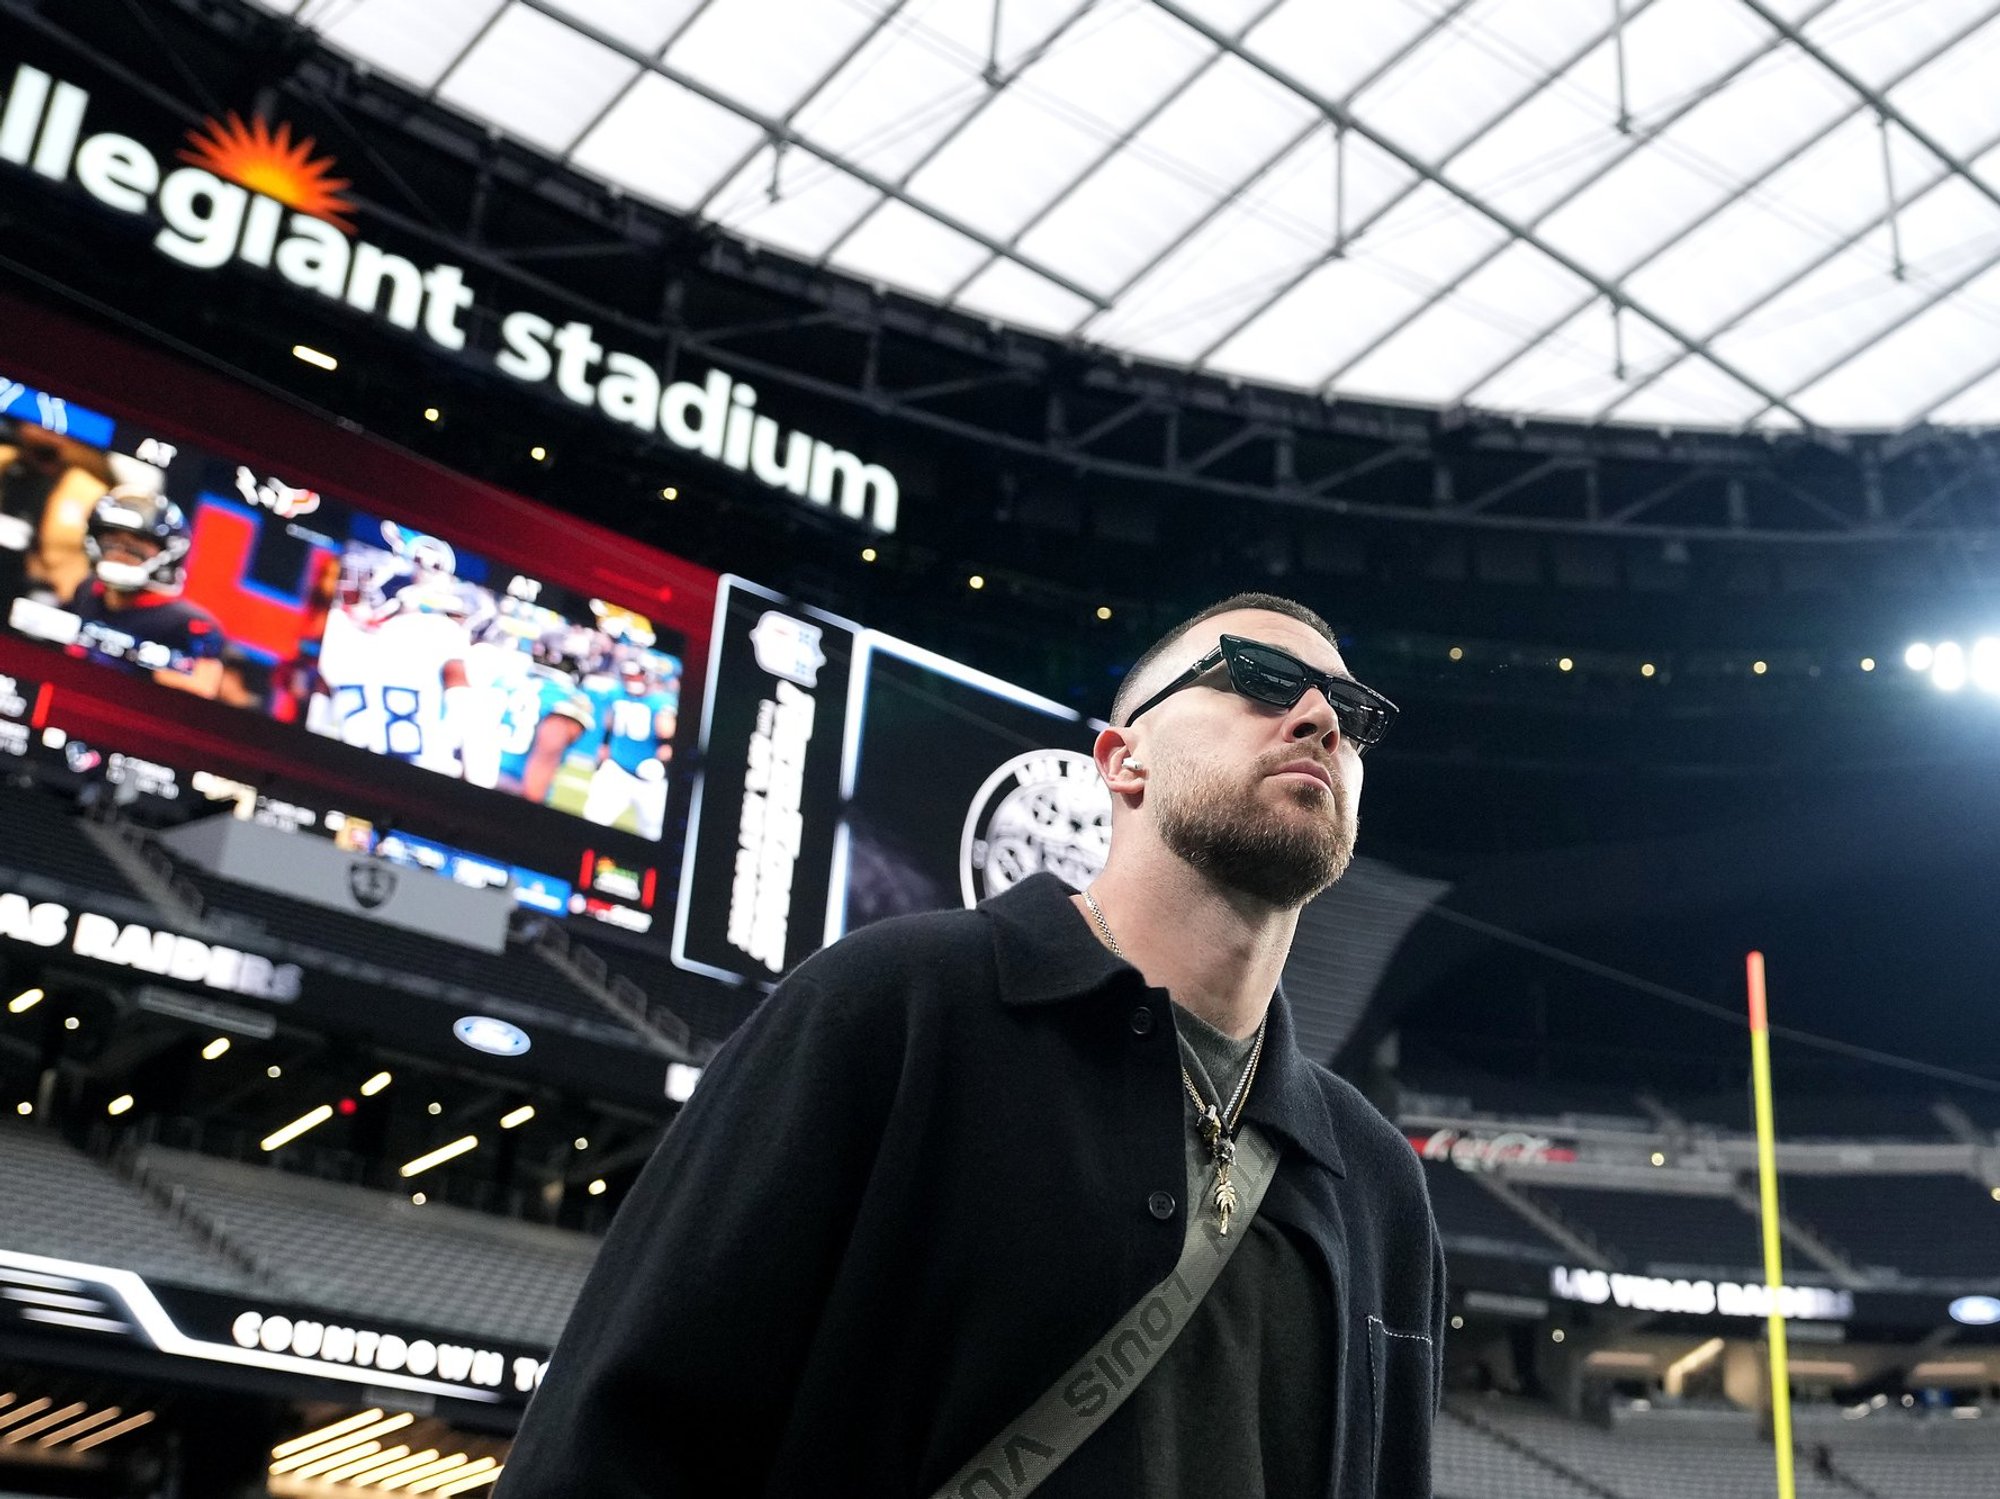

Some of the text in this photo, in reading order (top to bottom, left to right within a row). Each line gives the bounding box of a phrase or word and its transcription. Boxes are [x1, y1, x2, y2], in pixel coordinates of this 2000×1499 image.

[0, 63, 900, 534] llegiant stadium
[0, 892, 302, 1004] AS RAIDERS
[1552, 1265, 1611, 1304] LAS
[1609, 1272, 1717, 1315] VEGAS
[232, 1311, 505, 1387] COUNTDOWN
[948, 1270, 1193, 1499] LOUIS VU
